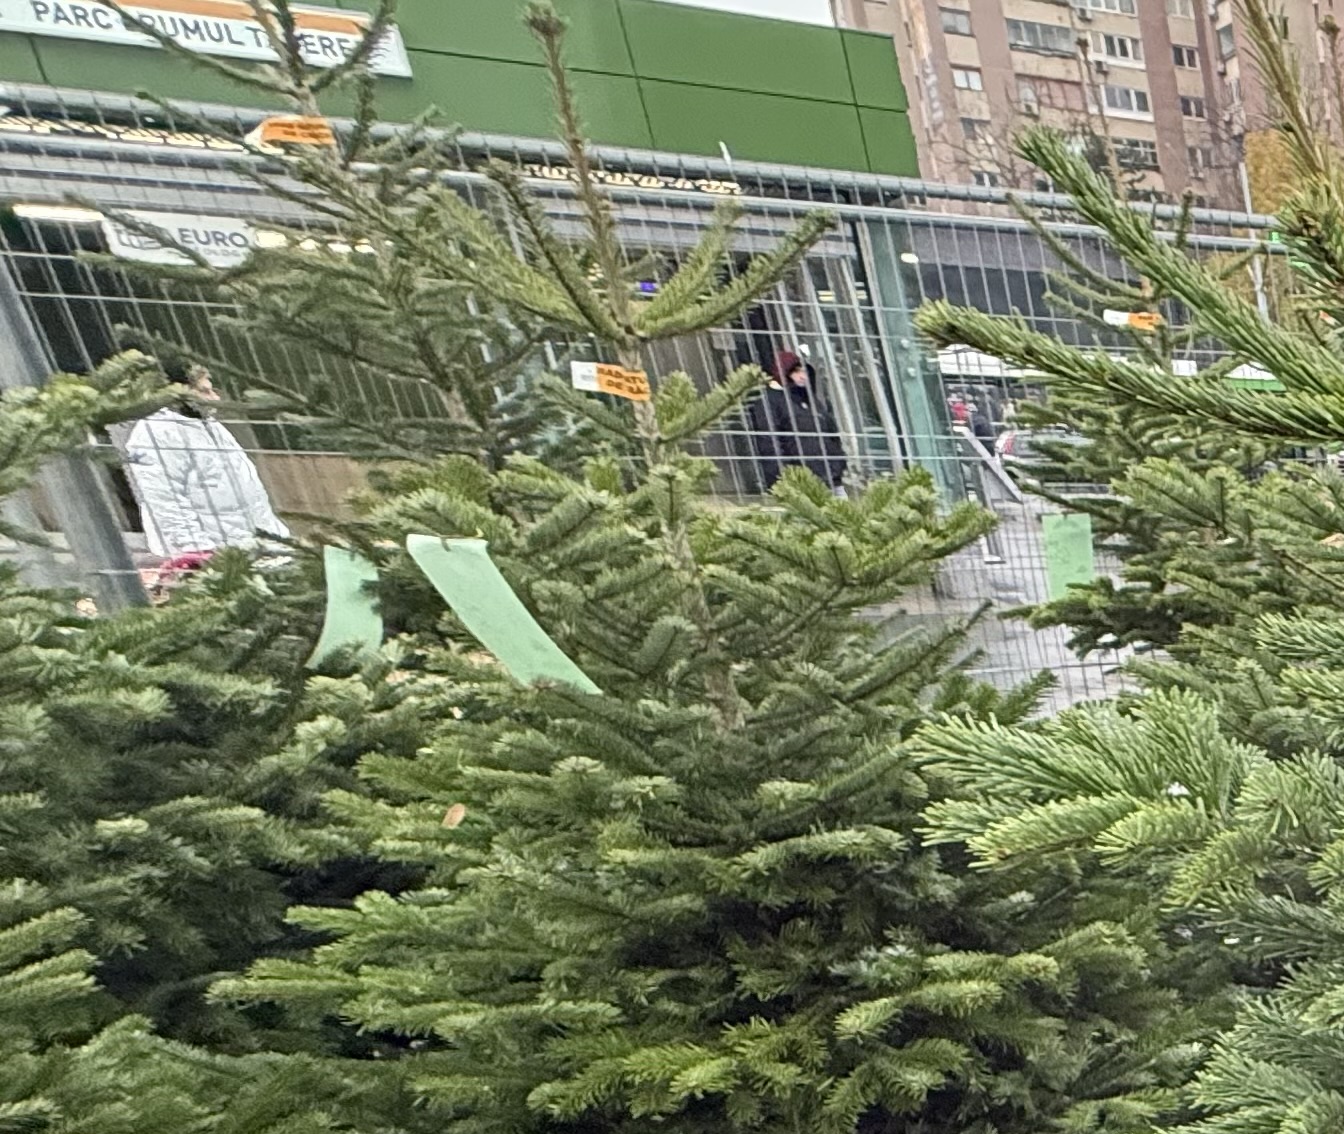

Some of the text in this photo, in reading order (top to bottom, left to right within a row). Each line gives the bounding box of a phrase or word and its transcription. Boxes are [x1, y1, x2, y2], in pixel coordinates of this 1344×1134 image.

[31, 0, 113, 29] PARC
[121, 14, 244, 47] RUMUL
[177, 227, 249, 248] EURO
